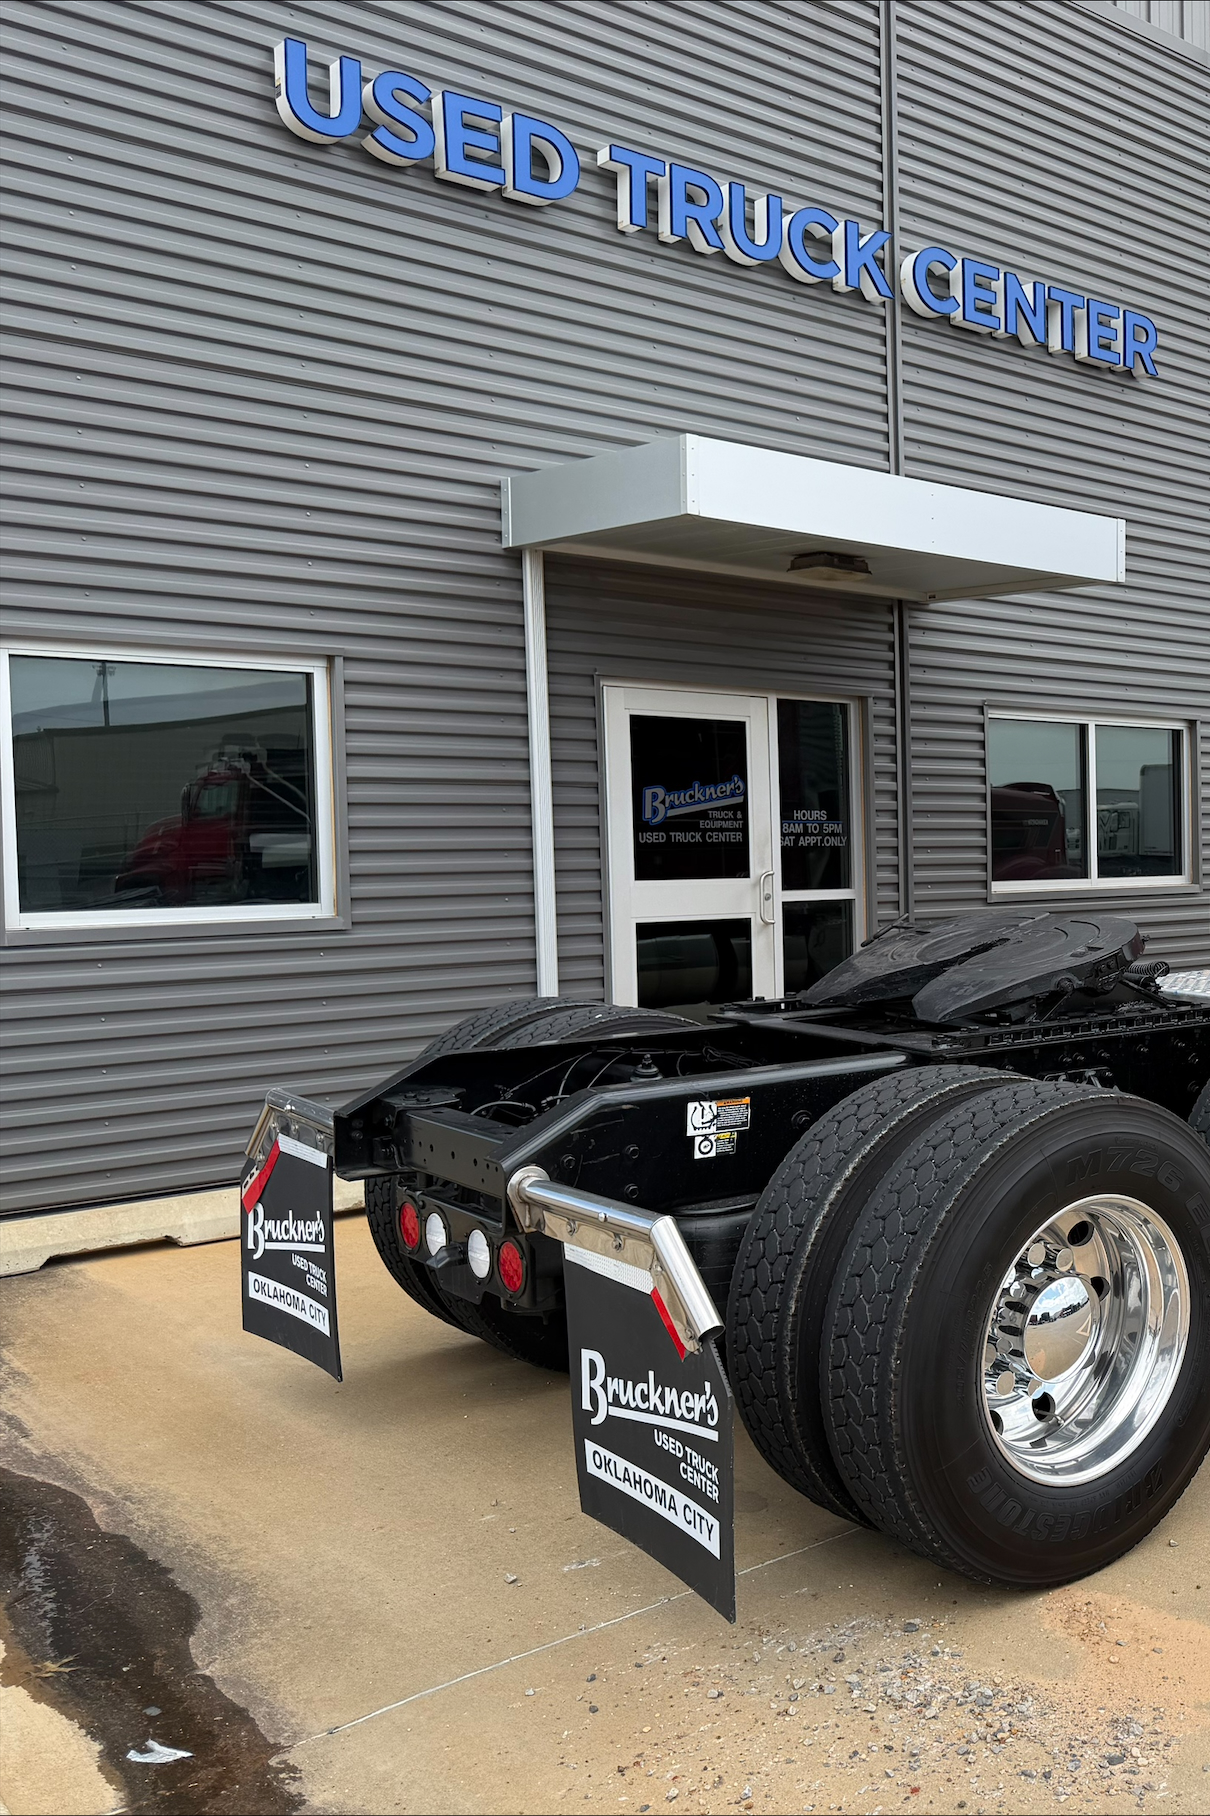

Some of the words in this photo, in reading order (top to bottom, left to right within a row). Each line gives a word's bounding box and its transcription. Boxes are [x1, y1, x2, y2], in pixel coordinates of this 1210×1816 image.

[276, 36, 581, 204] USED
[600, 143, 895, 302] TRUCK
[904, 246, 1159, 377] CENTER
[642, 774, 746, 826] Bruckner's
[707, 810, 734, 819] TRUCK
[736, 810, 742, 819] &
[793, 809, 828, 821] HOURS
[638, 832, 667, 844] USED
[669, 831, 703, 843] TRUCK
[705, 831, 743, 843] CENTER
[699, 820, 744, 829] EQUIPMENT
[782, 823, 804, 834] 8AM
[806, 823, 820, 834] TO
[822, 823, 843, 834] 5PM
[1064, 1146, 1186, 1193] M726
[247, 1202, 325, 1260] Bruckner's
[291, 1253, 308, 1272] USED
[308, 1261, 327, 1284] TRUCK
[305, 1273, 328, 1298] CENTER
[253, 1278, 307, 1316] OKLAHOMA
[308, 1303, 327, 1327] CITY
[580, 1348, 719, 1427] Bruckner's
[654, 1428, 684, 1459] USED
[684, 1445, 720, 1486] TRUCK
[592, 1449, 679, 1518] OKLAHOMA
[683, 1502, 715, 1543] CITY
[679, 1462, 720, 1504] CENTER
[965, 1455, 1165, 1543] BRIDGESTONE
